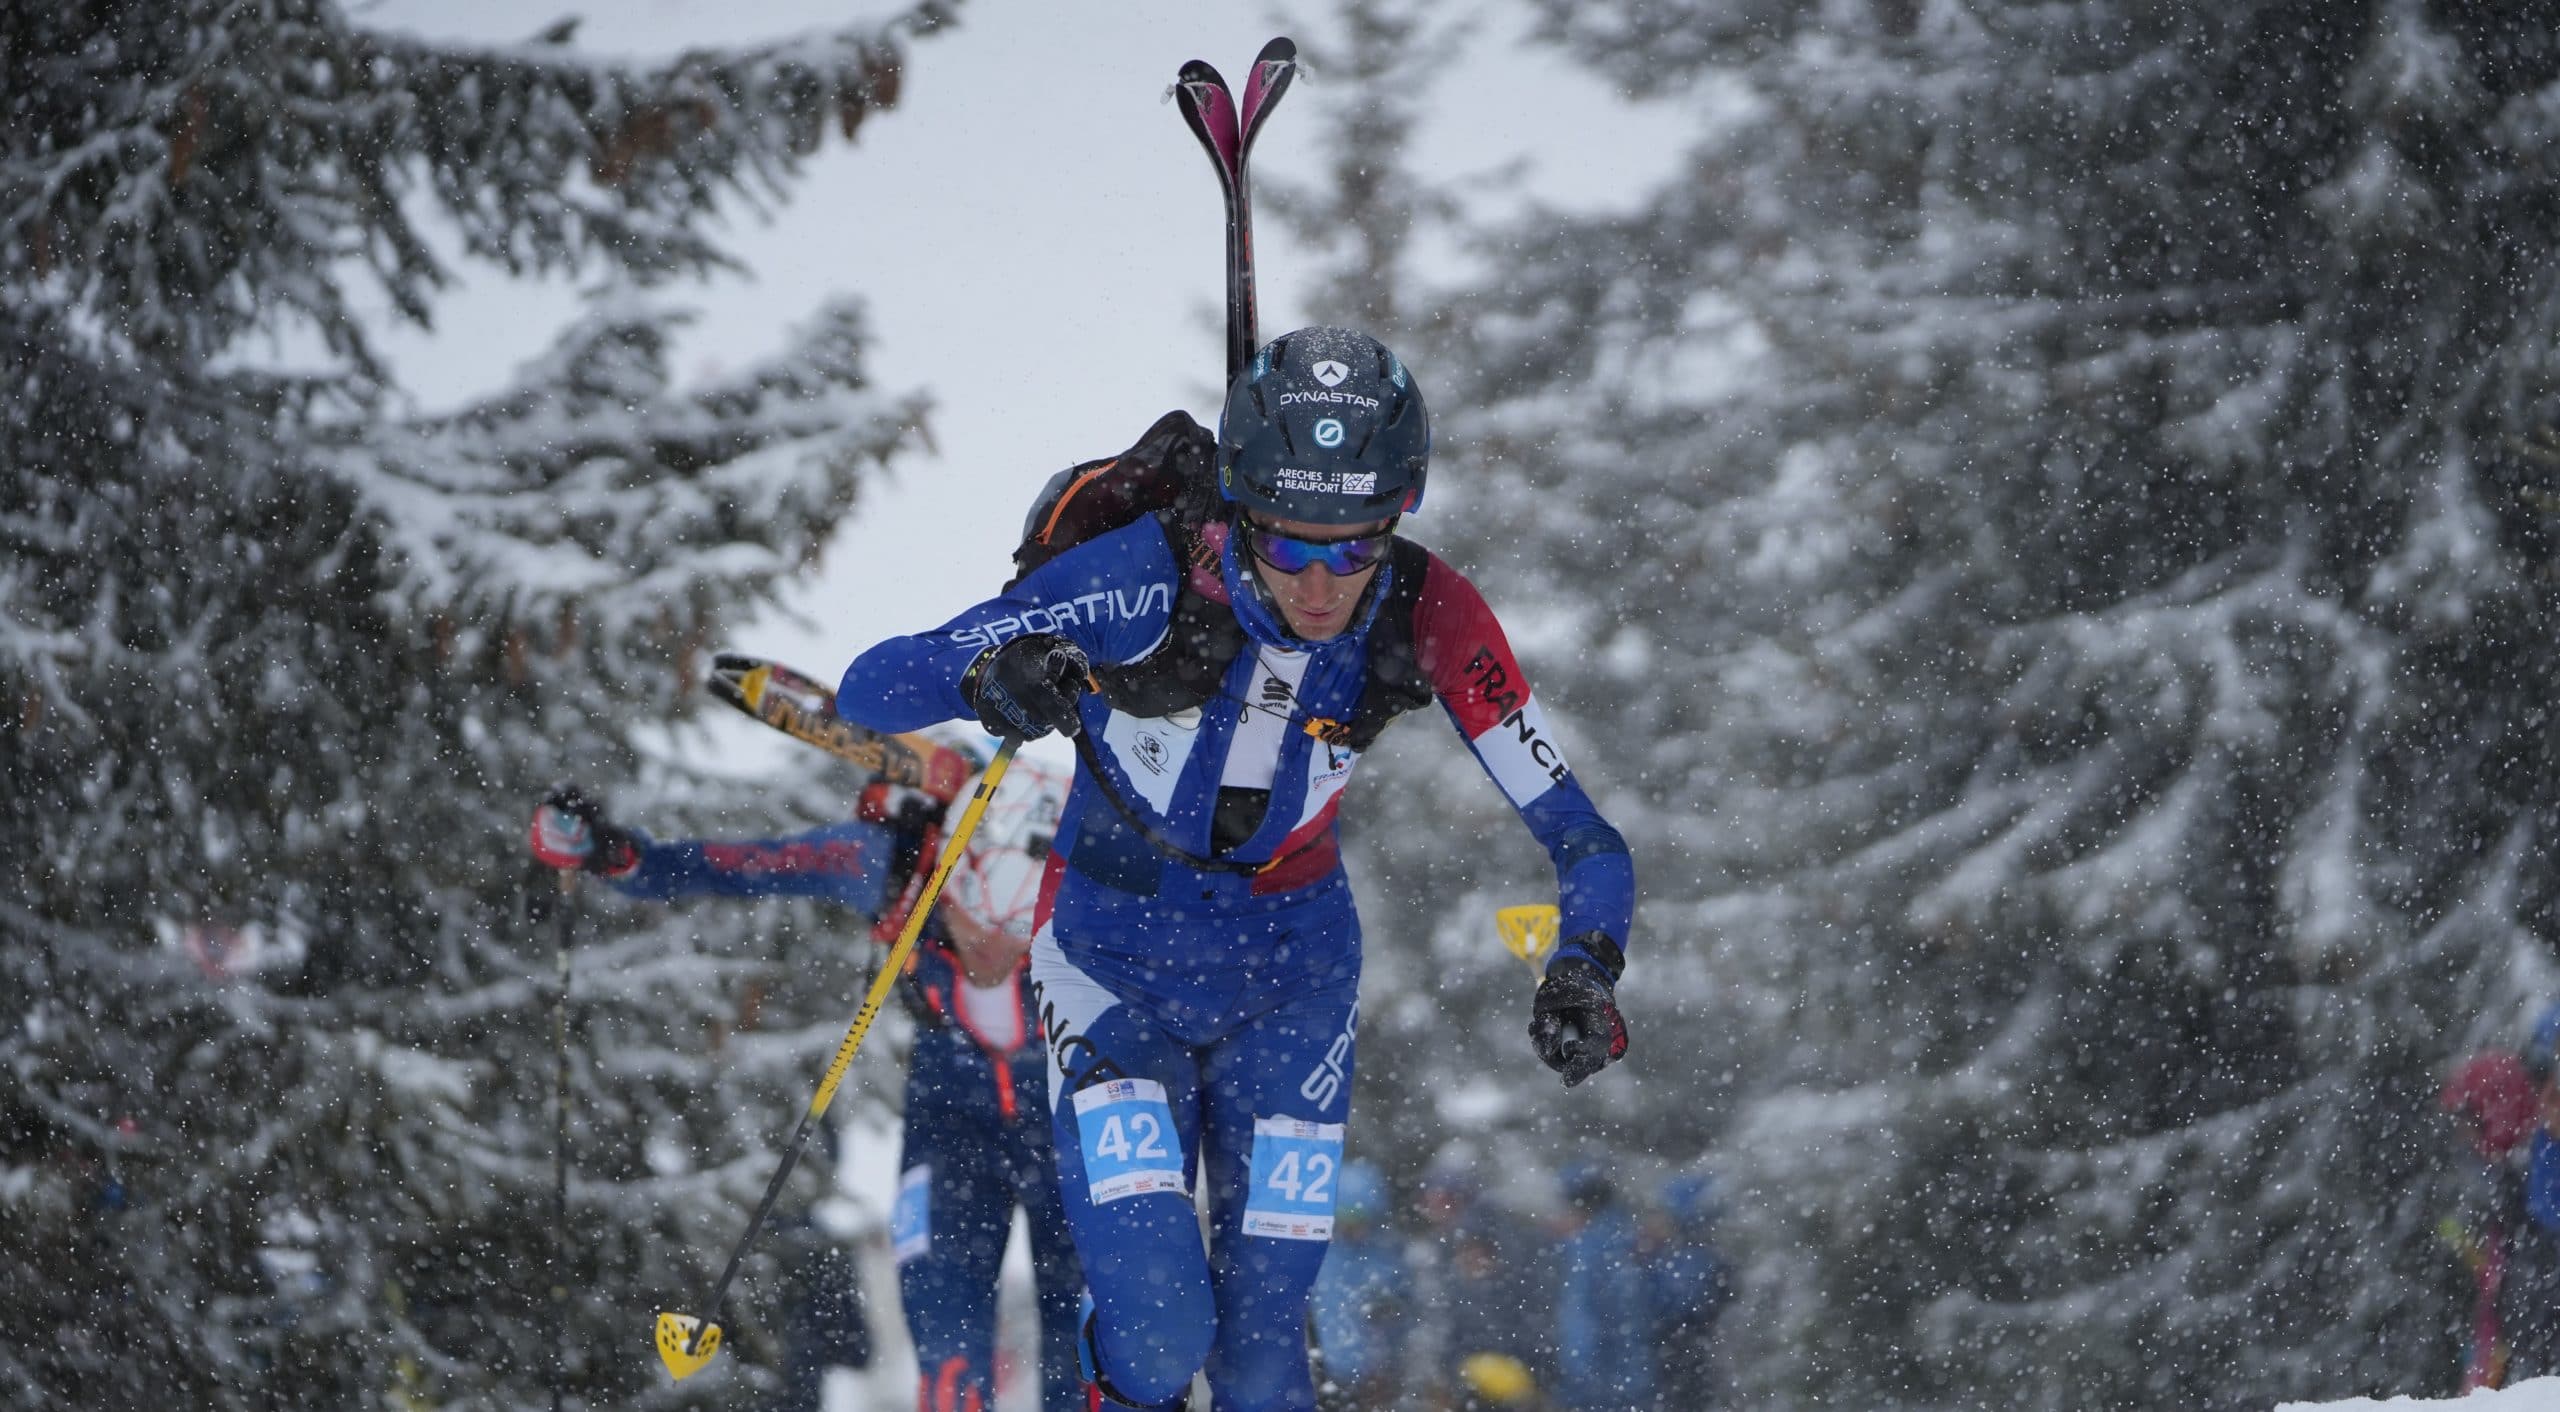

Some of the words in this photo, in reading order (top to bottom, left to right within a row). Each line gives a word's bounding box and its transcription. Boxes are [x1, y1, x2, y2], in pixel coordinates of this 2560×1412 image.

[1280, 390, 1379, 410] DYNASTAR
[1277, 467, 1323, 482] ARECHES
[1284, 479, 1340, 494] BEAUFORT
[950, 582, 1169, 649] SPORTIVA
[1463, 645, 1568, 791] FRANCE
[1096, 1112, 1168, 1163] 42
[1267, 1150, 1334, 1203] 42
